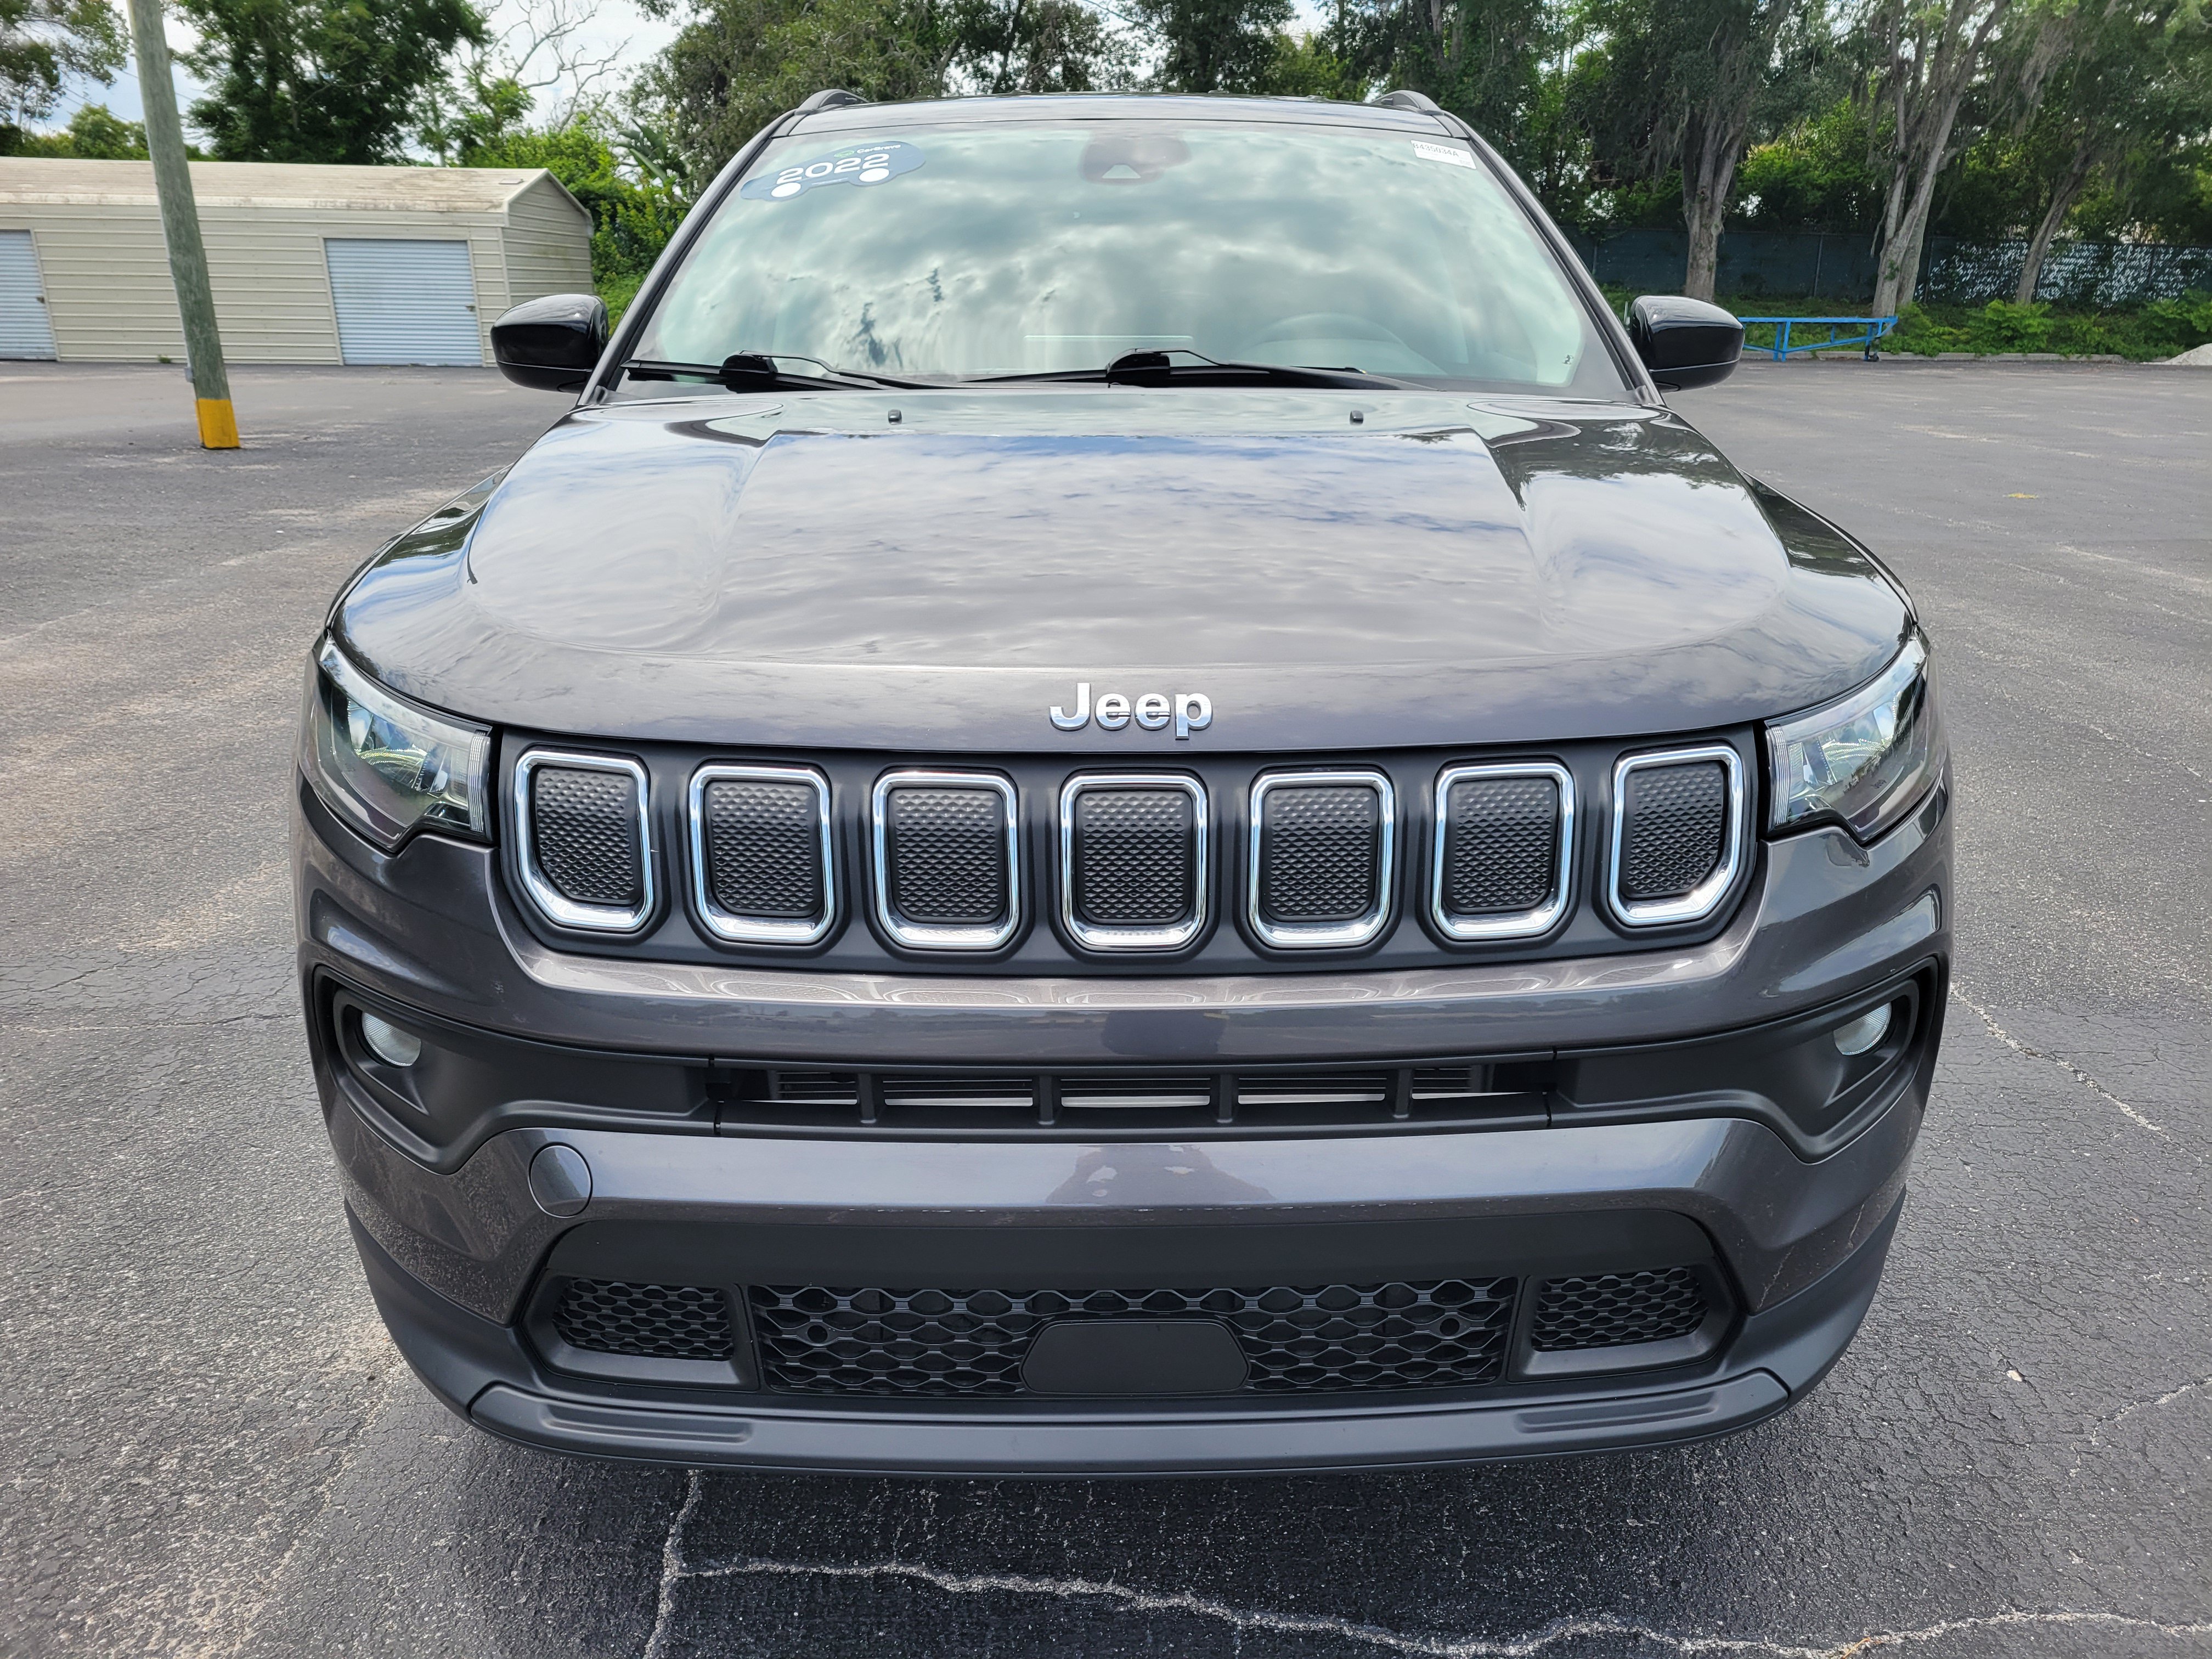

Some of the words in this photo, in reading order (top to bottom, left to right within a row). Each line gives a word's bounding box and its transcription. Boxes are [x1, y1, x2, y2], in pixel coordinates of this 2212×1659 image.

[857, 144, 901, 154] CarBravo
[776, 154, 890, 184] 2022
[1049, 682, 1213, 741] Jeep
